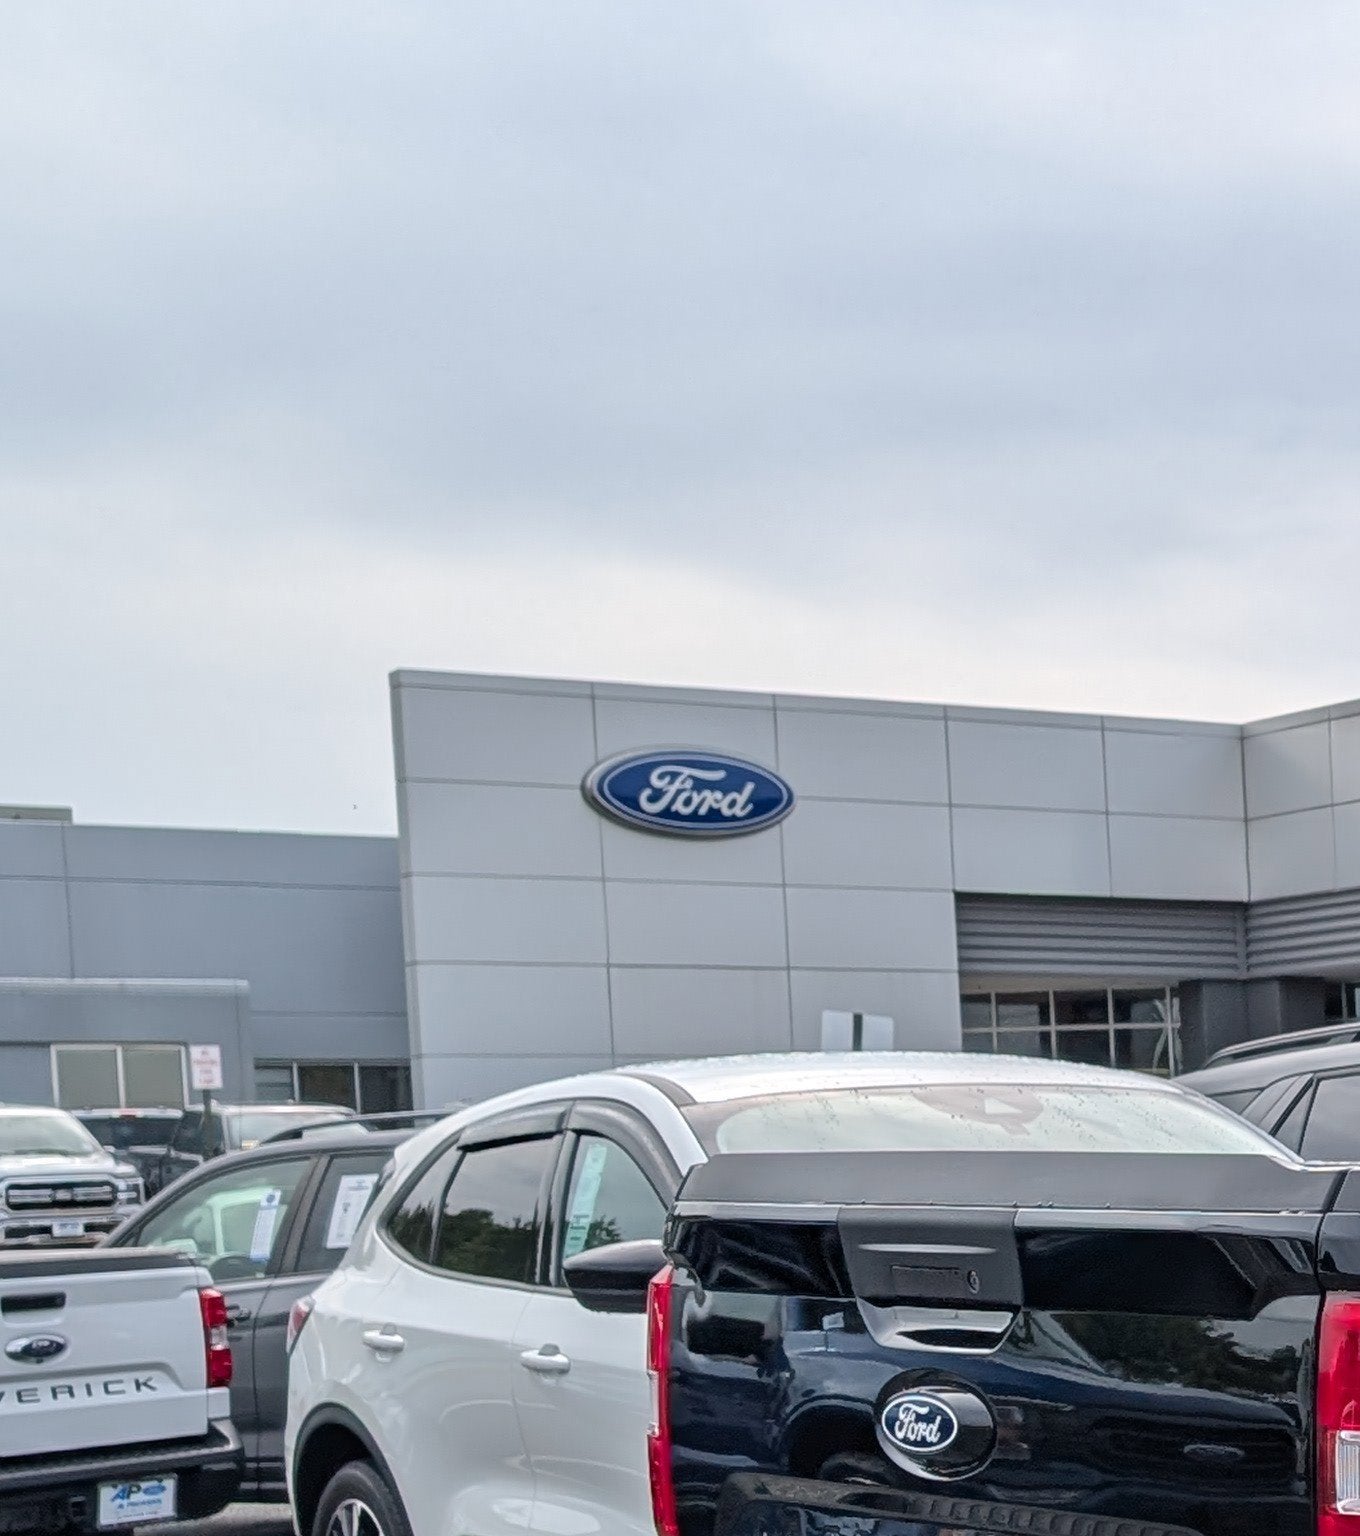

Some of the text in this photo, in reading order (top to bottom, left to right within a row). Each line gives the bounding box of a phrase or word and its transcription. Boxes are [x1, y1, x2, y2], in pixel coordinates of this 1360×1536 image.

[638, 764, 756, 818] Ford
[0, 1376, 158, 1405] ERICK
[894, 1402, 942, 1444] Ford
